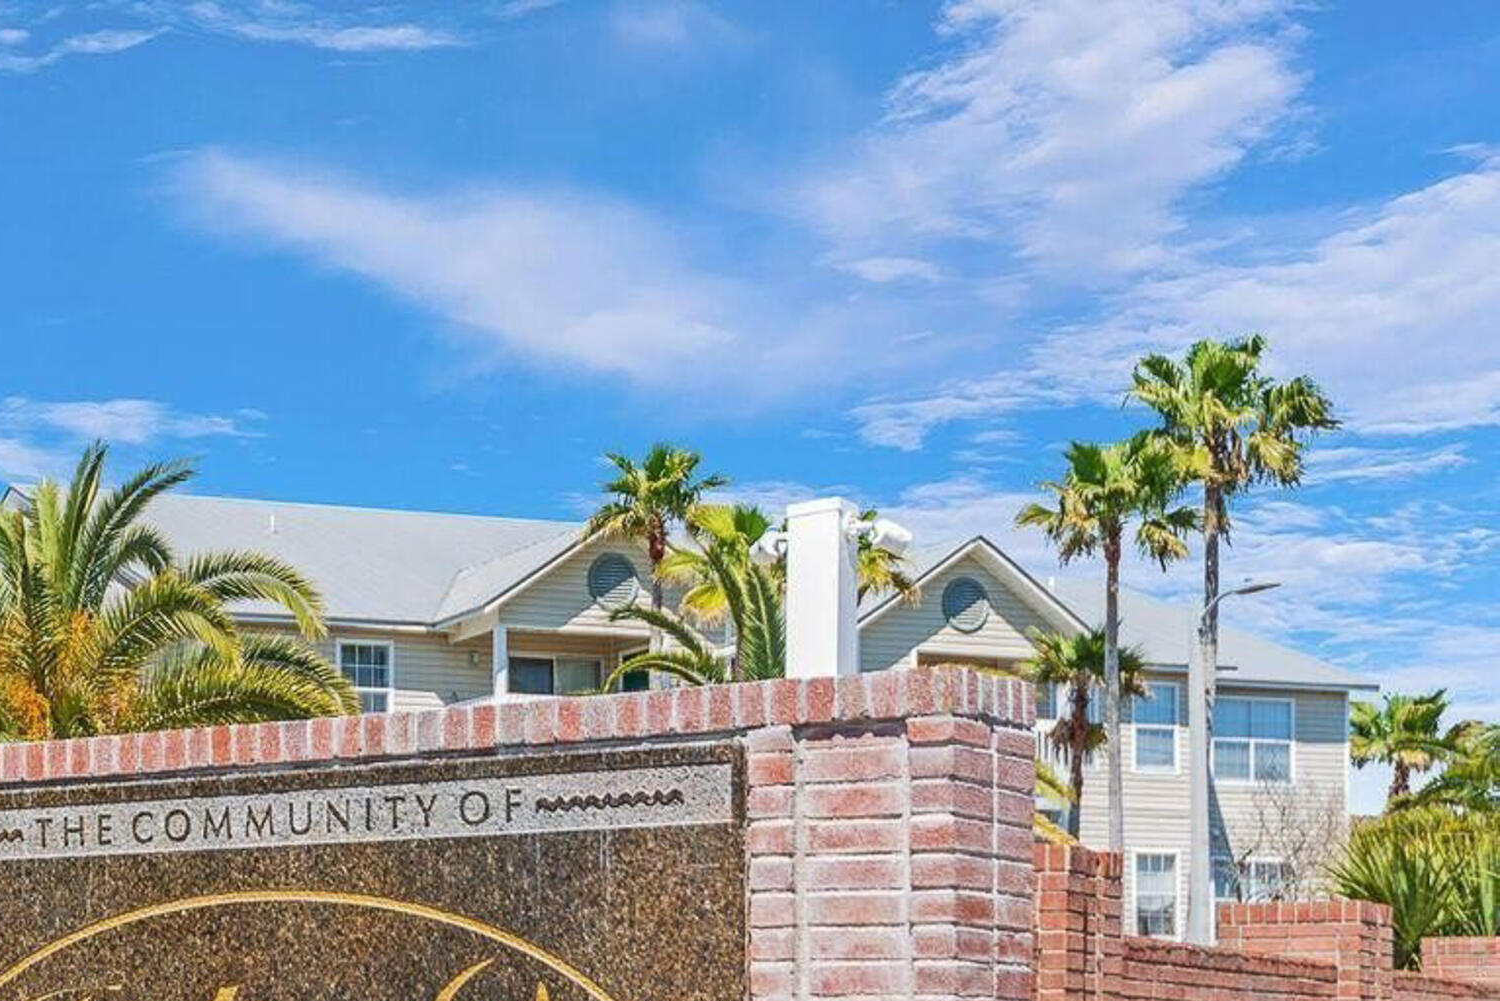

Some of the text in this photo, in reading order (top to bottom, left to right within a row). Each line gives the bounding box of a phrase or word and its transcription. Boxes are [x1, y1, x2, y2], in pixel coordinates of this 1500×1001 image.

[34, 788, 523, 849] THE COMMUNITY OF
